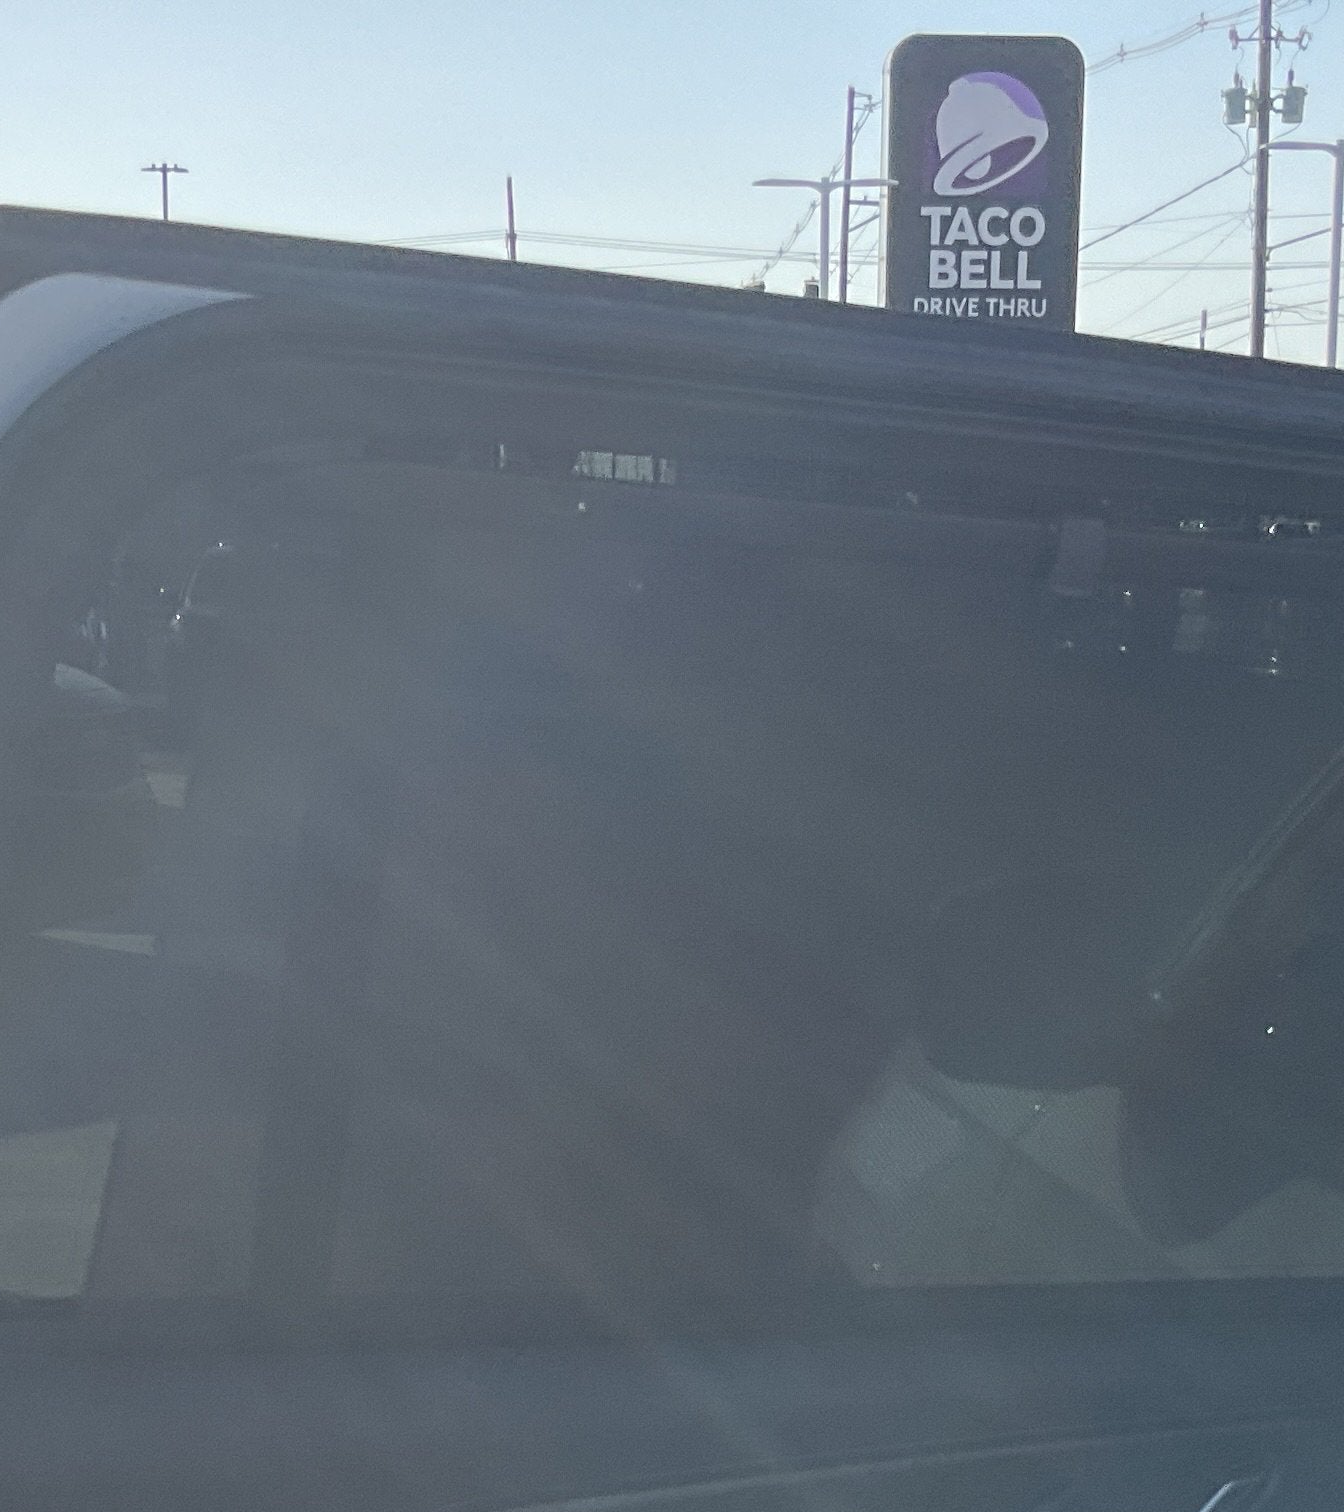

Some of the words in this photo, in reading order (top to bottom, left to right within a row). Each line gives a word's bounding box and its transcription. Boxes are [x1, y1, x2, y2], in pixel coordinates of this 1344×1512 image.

[920, 205, 1046, 247] TACO
[928, 250, 1042, 289] BELL
[913, 297, 979, 317] DRIVE
[985, 297, 1047, 318] THRU
